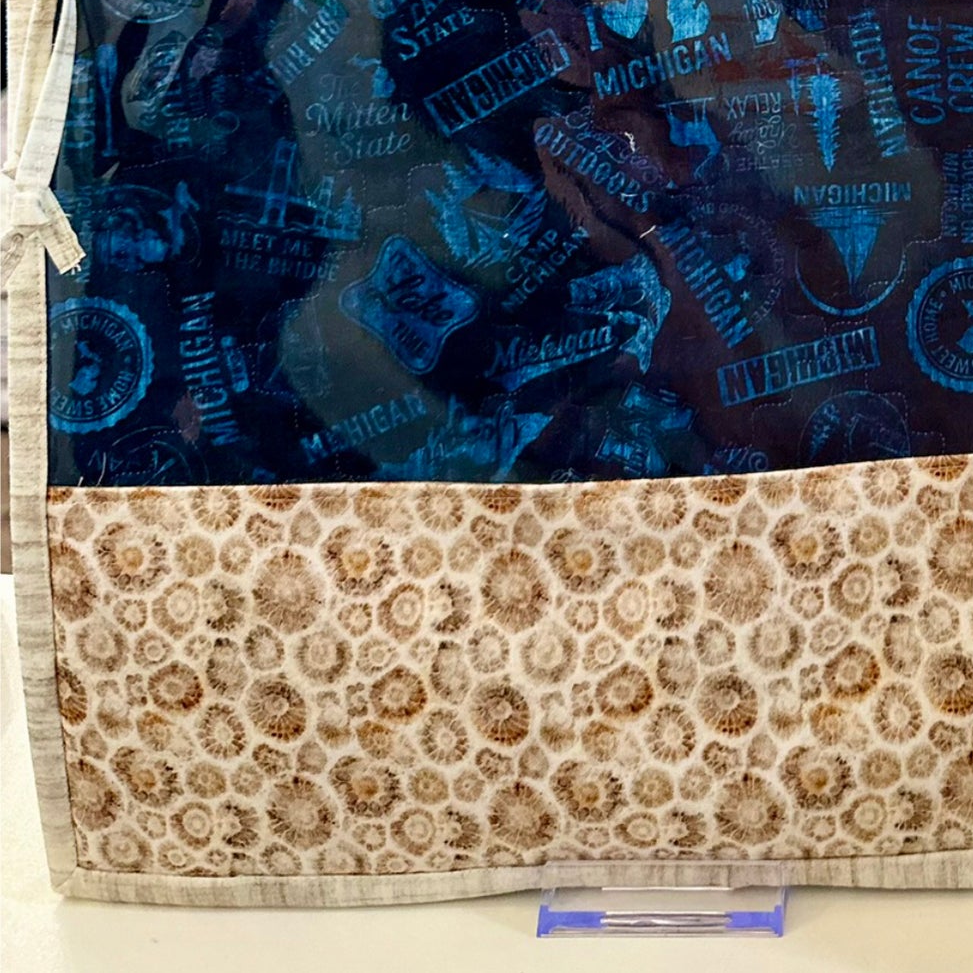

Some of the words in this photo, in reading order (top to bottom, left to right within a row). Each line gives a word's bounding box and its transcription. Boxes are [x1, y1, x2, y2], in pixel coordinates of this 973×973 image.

[391, 7, 476, 62] STATE
[593, 31, 733, 100] MICHIGAN
[847, 7, 909, 159] MICHIGAN
[905, 14, 946, 125] CANOE
[305, 102, 414, 137] Mitten
[724, 91, 783, 121] RELAX
[334, 132, 417, 166] State
[534, 121, 656, 214] OUTDOORS
[793, 181, 912, 205] MICHIGAN
[218, 227, 279, 252] MEET
[283, 237, 314, 258] ME
[500, 225, 591, 312] MICHIGAN
[504, 227, 559, 284] CAMP
[658, 221, 754, 349] MICHIGAN
[58, 314, 135, 351] MICHIGAN
[922, 296, 945, 344] HOME
[178, 290, 240, 447] MICHIGAN
[484, 324, 615, 378] Michigan
[48, 391, 94, 416] SWEE
[99, 369, 135, 406] HOME
[299, 392, 428, 465] MICHIGAN
